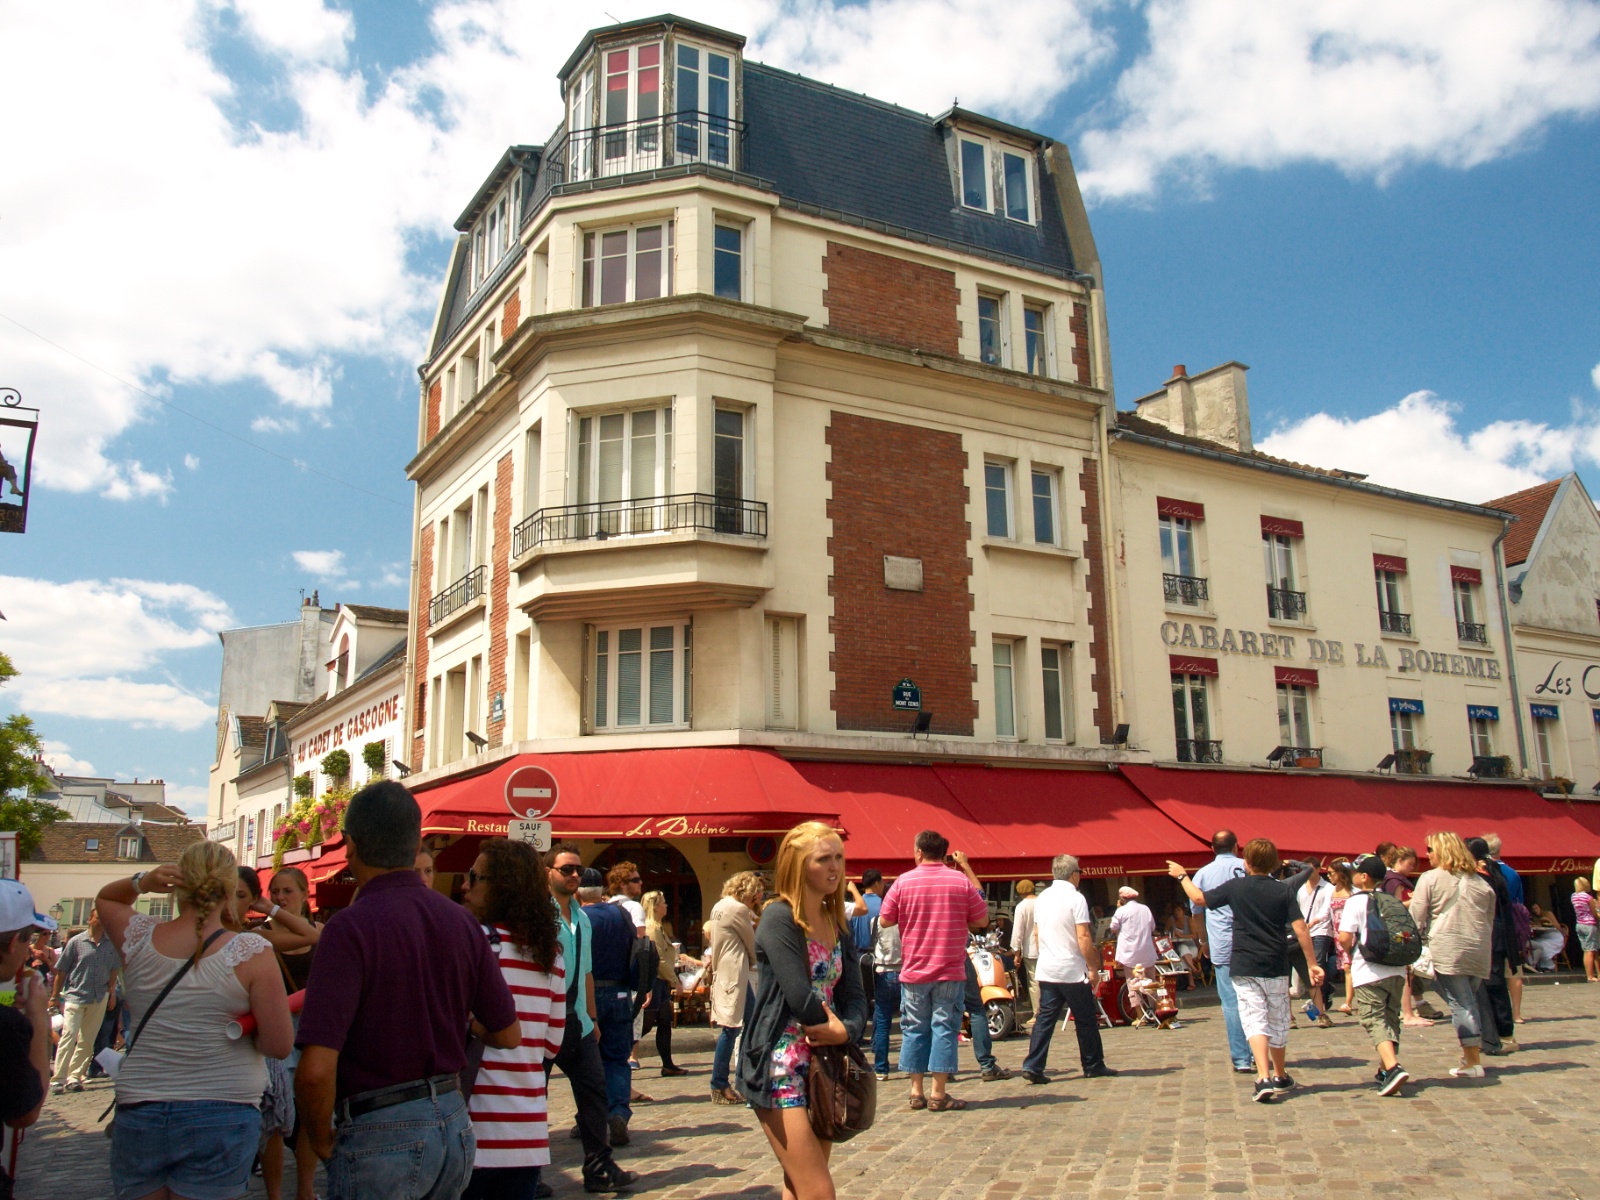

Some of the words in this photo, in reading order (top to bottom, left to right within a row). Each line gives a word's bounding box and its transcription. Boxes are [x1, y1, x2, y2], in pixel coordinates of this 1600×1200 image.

[1160, 620, 1296, 661] CABARET
[1307, 638, 1345, 666] DE
[1354, 643, 1390, 669] LA
[1398, 648, 1501, 680] BOHEME
[1535, 660, 1572, 695] Les
[297, 744, 307, 764] AU
[308, 729, 331, 758] CADET
[333, 722, 344, 748] DE
[347, 694, 399, 740] GASCOGNE
[467, 819, 509, 833] Restau
[519, 823, 542, 831] SAUF
[625, 817, 654, 836] La
[655, 815, 730, 836] Bohème
[1081, 865, 1124, 876] staurant
